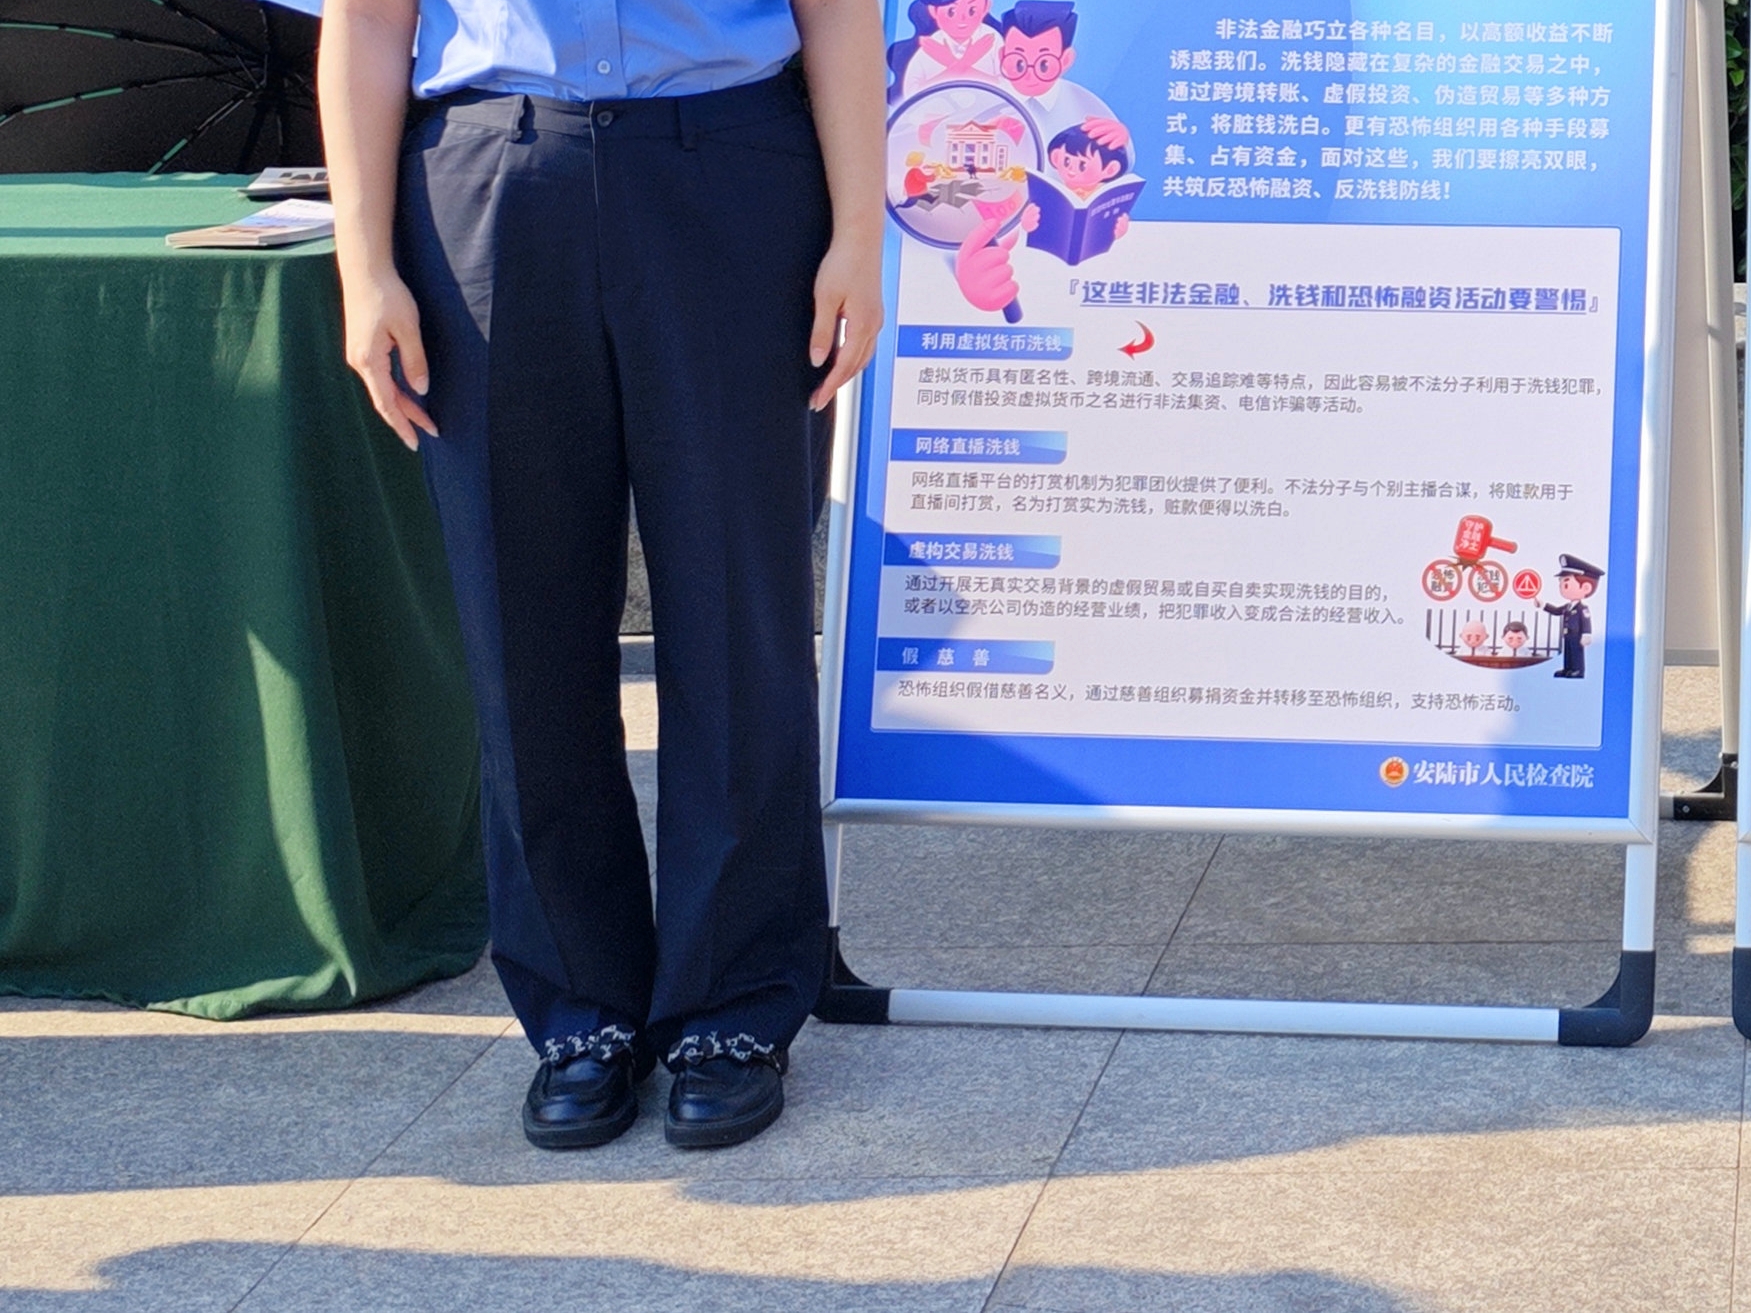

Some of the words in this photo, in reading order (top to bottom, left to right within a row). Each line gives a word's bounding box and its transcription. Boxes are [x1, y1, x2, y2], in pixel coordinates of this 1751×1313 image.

[921, 332, 1063, 353] 利用虚拟货币洗钱
[915, 436, 1021, 457] 网络直播洗钱
[908, 540, 1016, 562] 虚构交易洗钱
